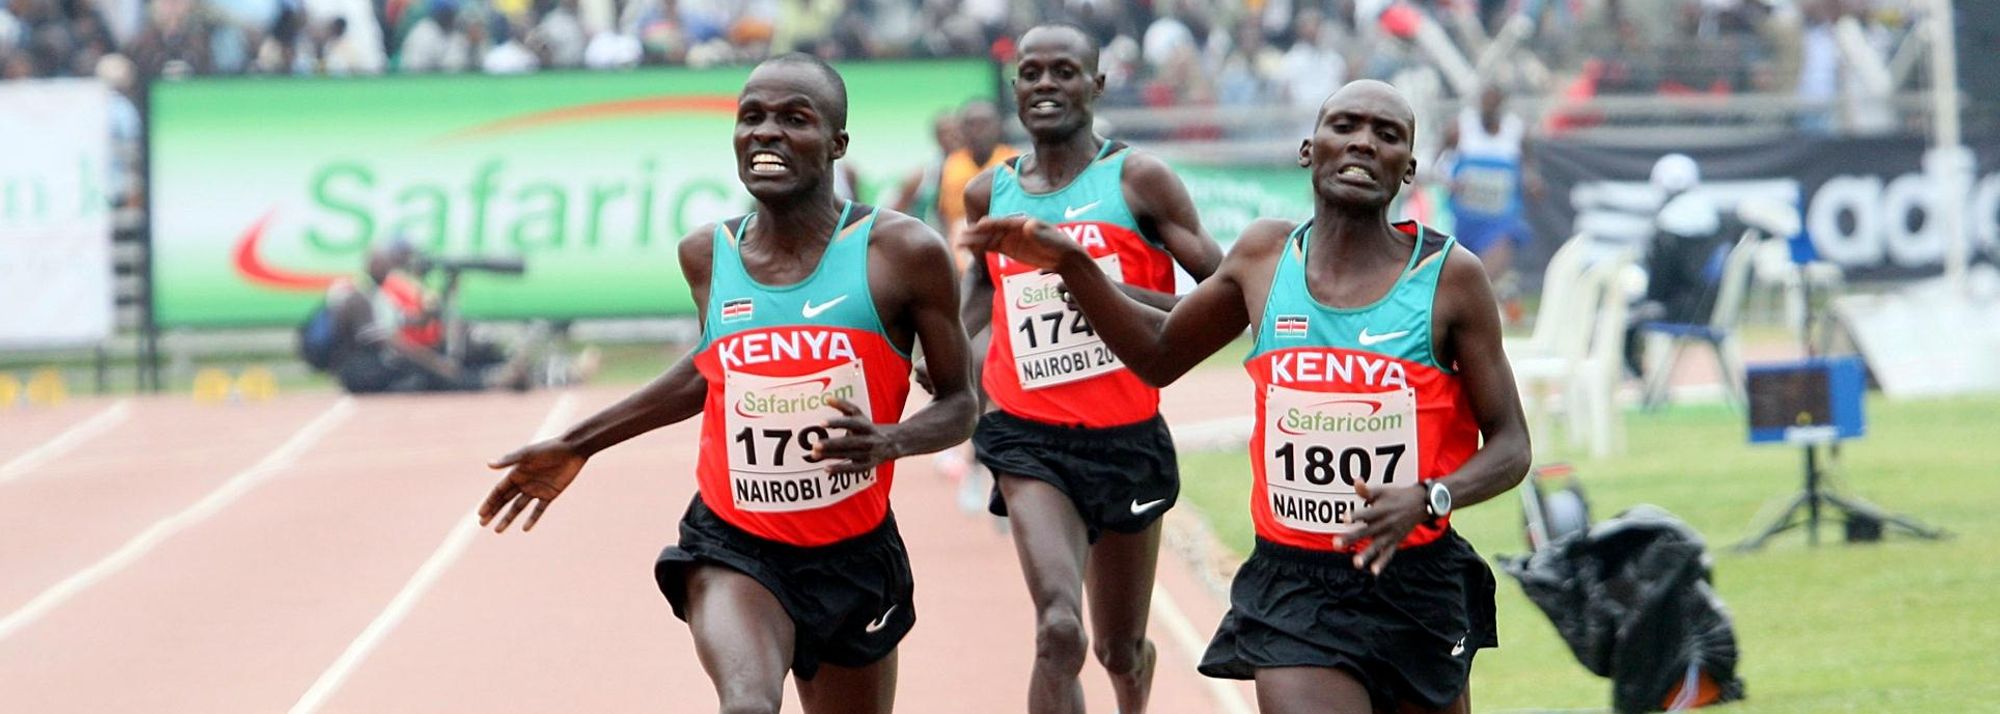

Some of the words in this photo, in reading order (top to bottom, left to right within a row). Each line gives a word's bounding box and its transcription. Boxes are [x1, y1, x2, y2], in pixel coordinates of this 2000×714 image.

[303, 158, 733, 256] Safaric
[1019, 311, 1094, 349] 174
[718, 331, 857, 370] KENYA
[1022, 350, 1091, 381] NAIROBI
[1094, 346, 1114, 366] 20
[1271, 352, 1409, 389] KENYA
[744, 384, 854, 414] Safaricom
[1287, 408, 1403, 432] Safaricom
[735, 425, 830, 466] 179
[1275, 443, 1407, 486] 1807
[736, 477, 822, 502] NAIROBI
